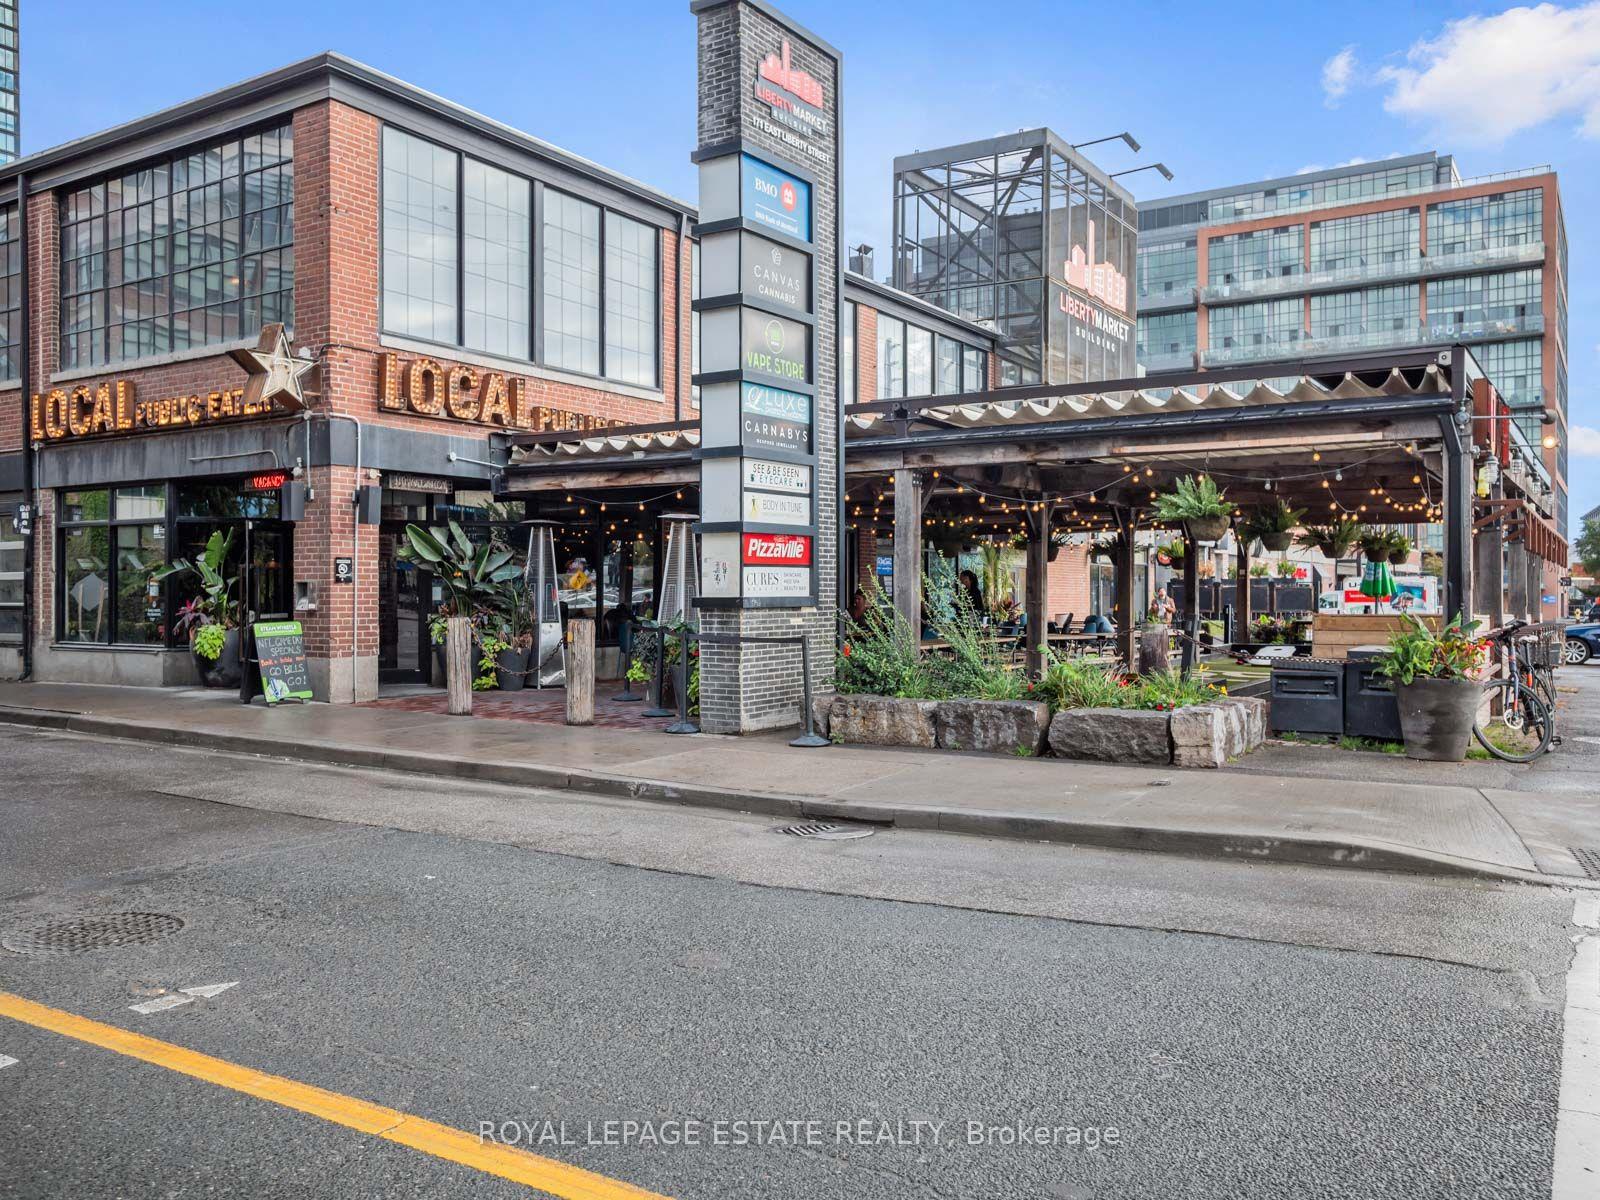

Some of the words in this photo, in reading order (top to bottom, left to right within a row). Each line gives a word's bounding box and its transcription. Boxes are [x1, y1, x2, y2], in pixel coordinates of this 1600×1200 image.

[773, 109, 813, 136] BUILDING
[753, 116, 764, 130] 171
[764, 121, 781, 138] EAST
[782, 131, 807, 153] LIBERTY
[807, 144, 830, 164] STREET
[755, 177, 777, 197] BMO
[754, 265, 800, 292] CANVAS
[758, 284, 796, 304] CANNABIS
[1076, 326, 1115, 352] BUILDING
[747, 352, 772, 372] VAPE
[774, 358, 805, 380] STORE
[378, 352, 532, 429] LOCAL
[31, 379, 136, 440] LOCAL
[135, 394, 201, 427] PUBLIC
[745, 420, 808, 442] CARNABYS
[753, 464, 765, 474] SEE
[766, 466, 771, 475] &
[772, 466, 781, 476] BE
[782, 467, 799, 478] SEEN
[759, 474, 793, 487] EYECARE
[253, 475, 285, 488] VACANCY
[762, 499, 778, 511] BODY
[780, 501, 786, 511] IN
[786, 501, 802, 513] TUNE
[746, 572, 779, 586] CURES
[269, 666, 281, 676] GO
[287, 675, 307, 686] GO!
